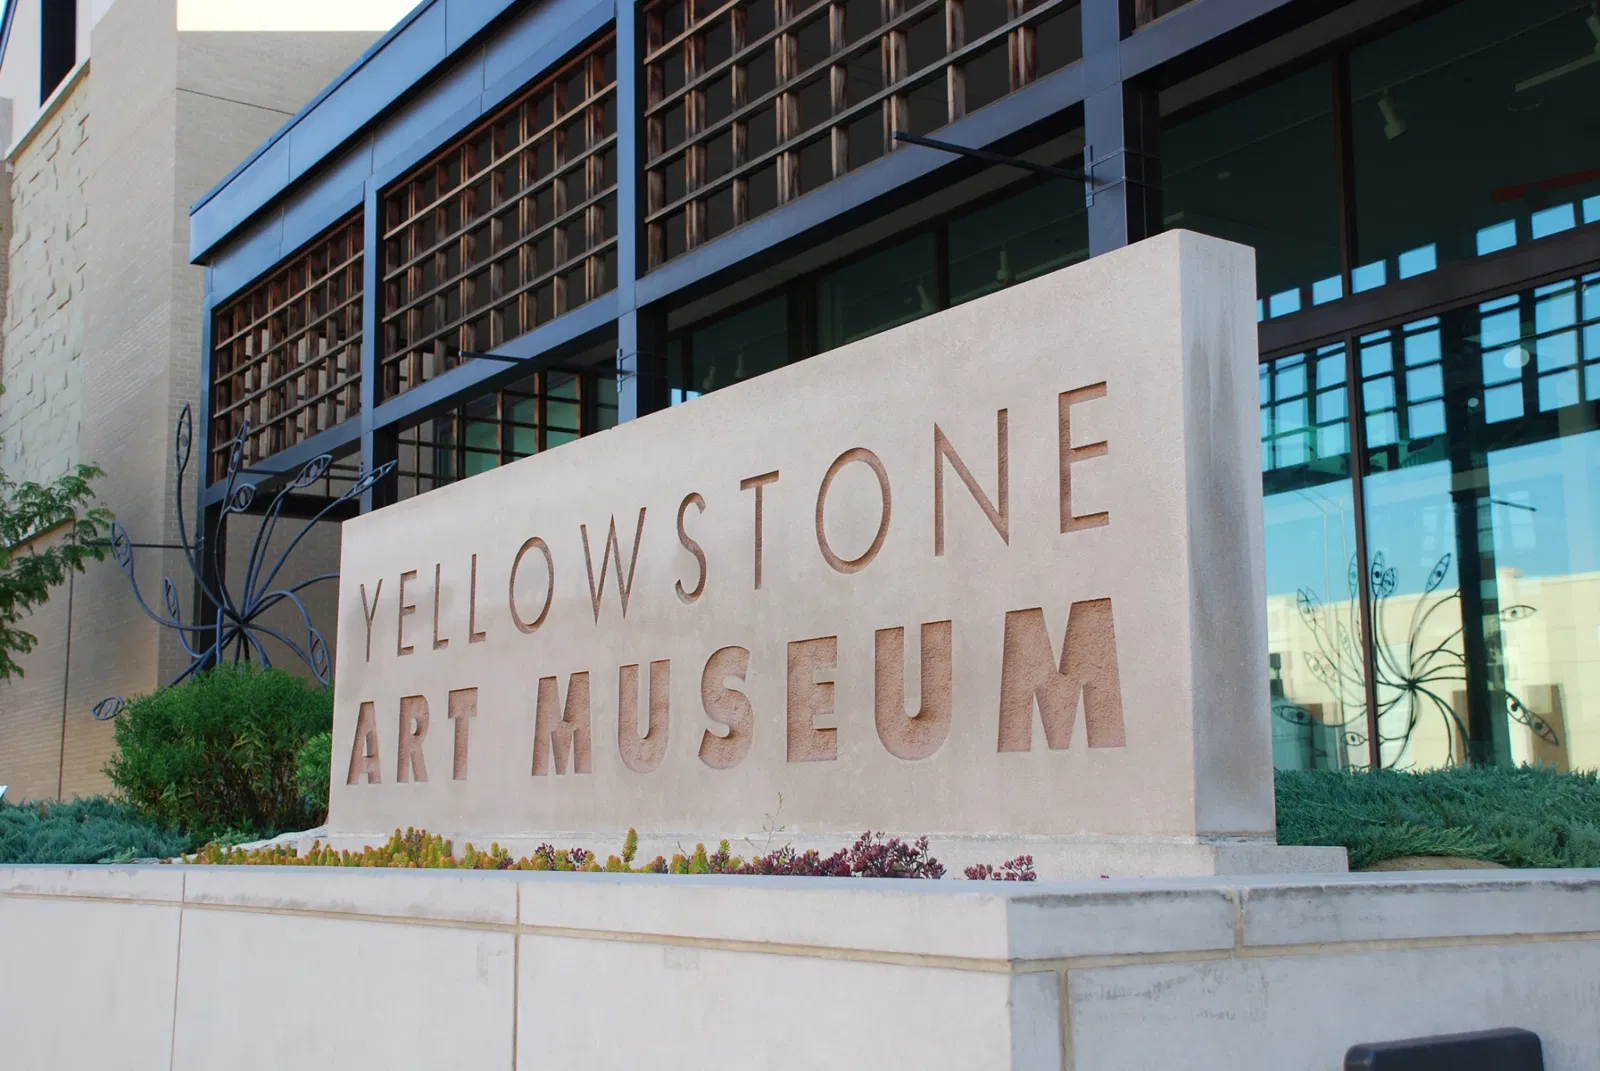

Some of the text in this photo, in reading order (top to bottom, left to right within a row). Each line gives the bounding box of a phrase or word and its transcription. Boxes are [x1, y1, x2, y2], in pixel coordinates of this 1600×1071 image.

[360, 381, 1110, 662] YELLOWSTONE
[346, 597, 1127, 786] ART MUSEUM
